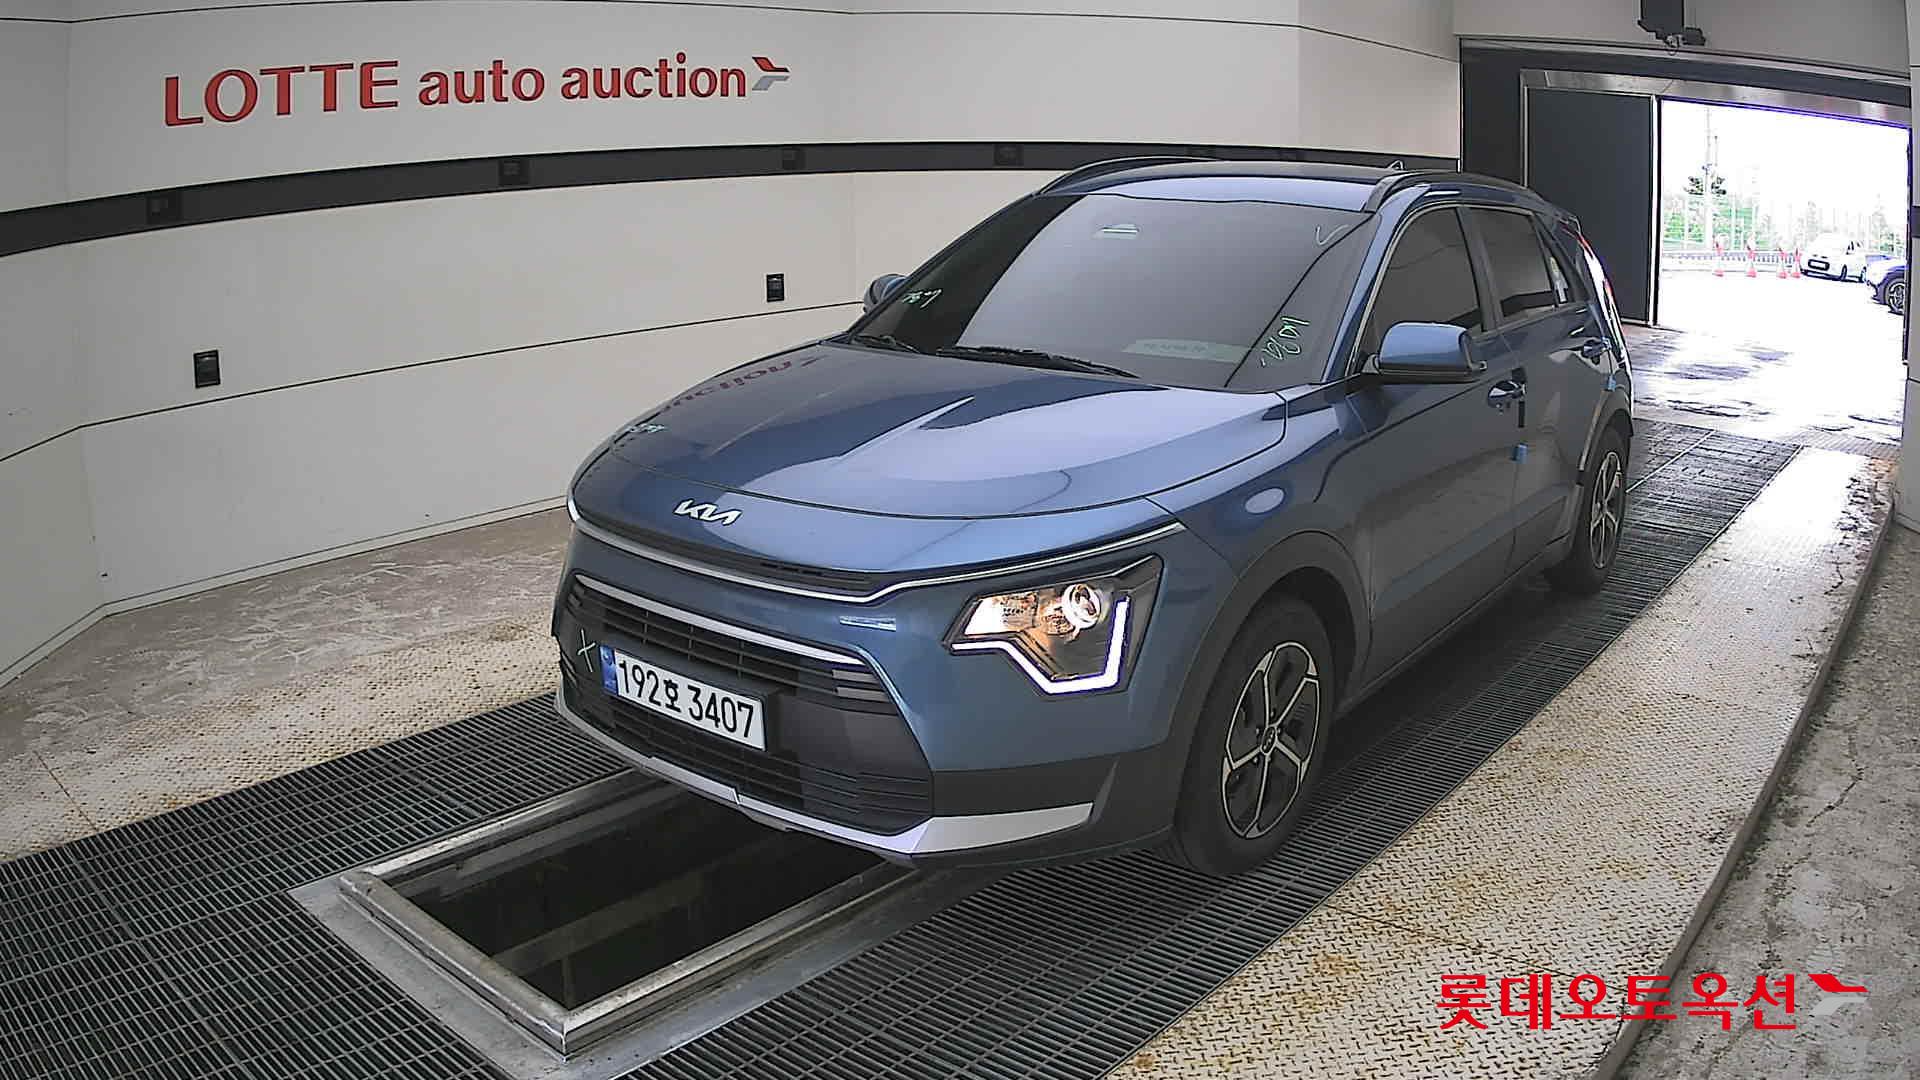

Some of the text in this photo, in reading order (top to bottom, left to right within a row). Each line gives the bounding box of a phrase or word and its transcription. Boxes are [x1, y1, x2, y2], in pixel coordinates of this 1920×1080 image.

[165, 52, 747, 126] LOTTE auto auction
[619, 660, 754, 738] 192호 3407
